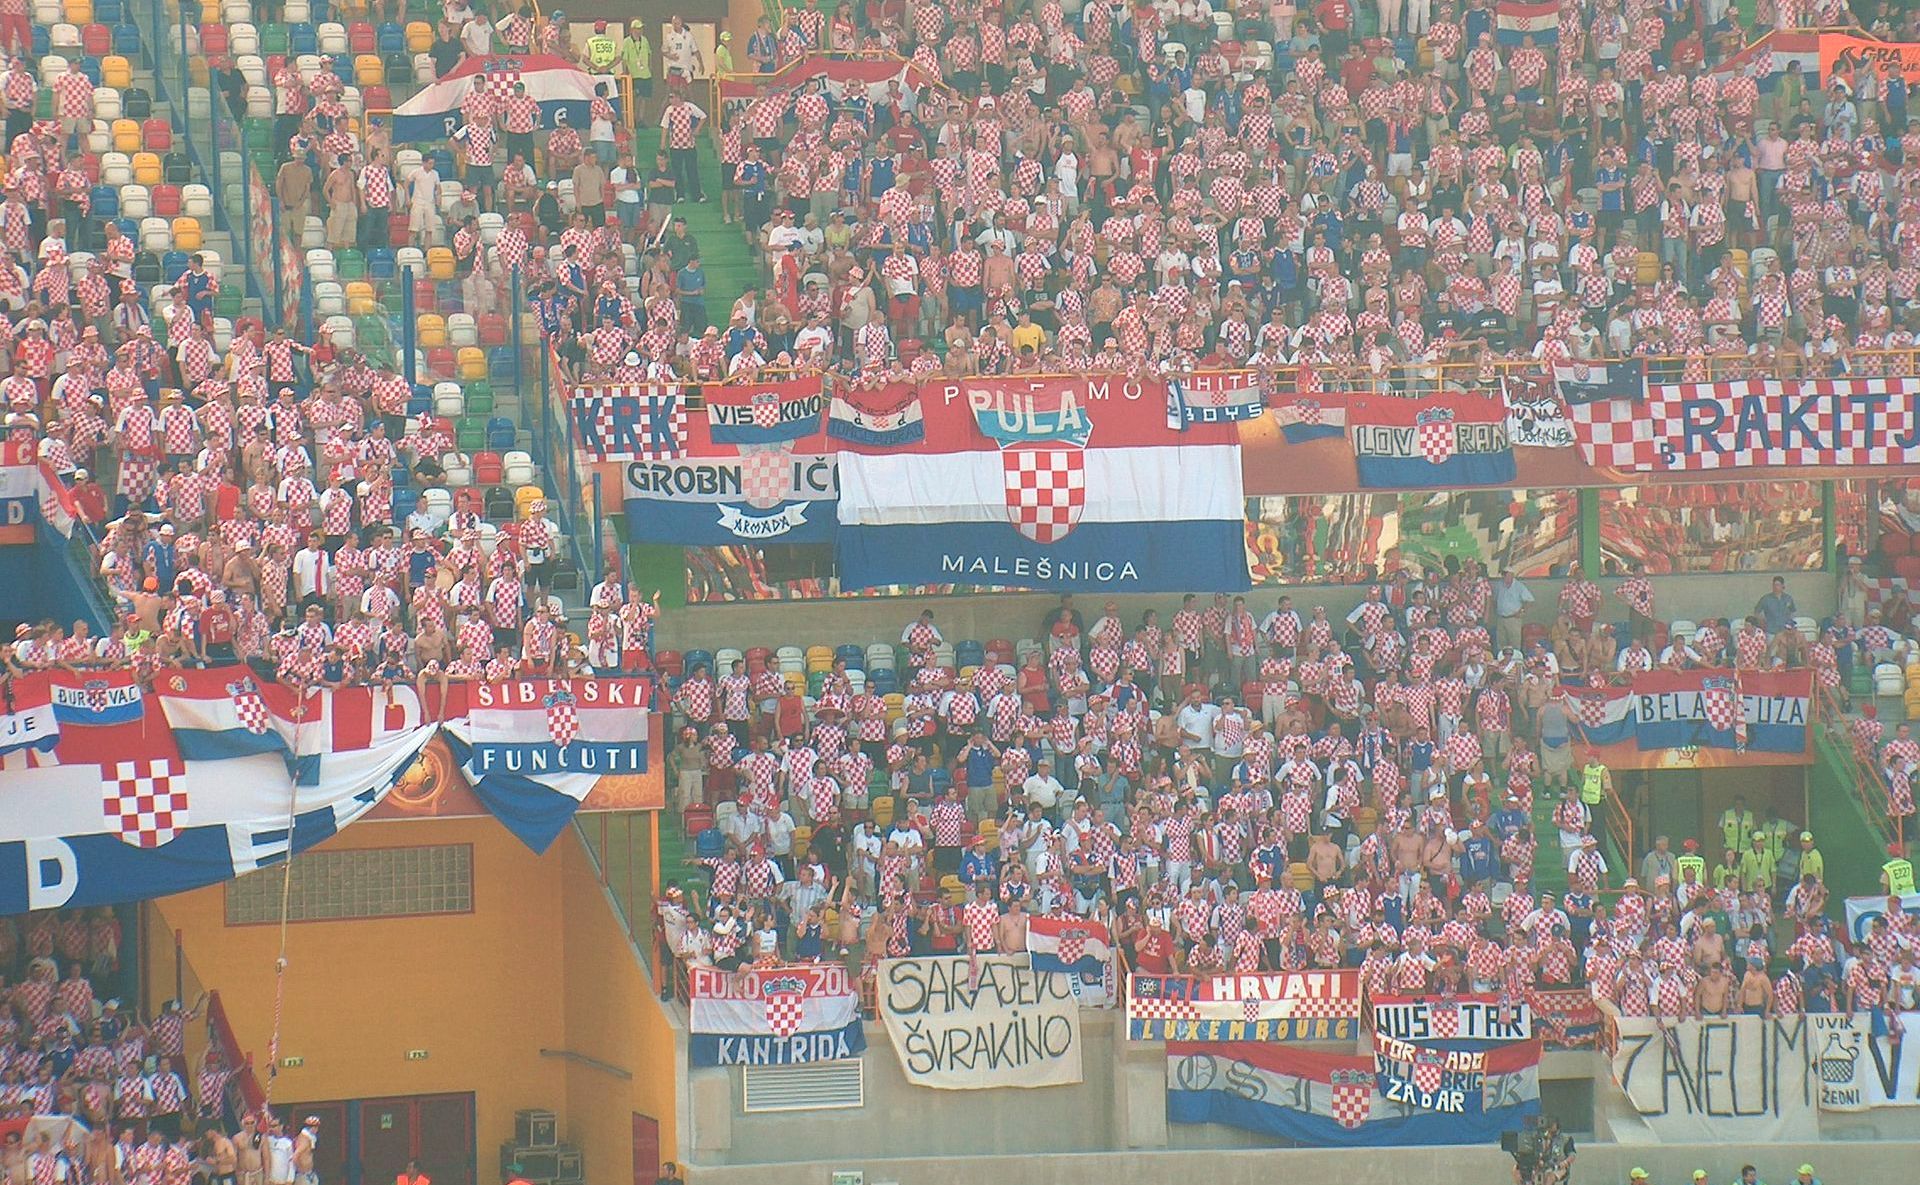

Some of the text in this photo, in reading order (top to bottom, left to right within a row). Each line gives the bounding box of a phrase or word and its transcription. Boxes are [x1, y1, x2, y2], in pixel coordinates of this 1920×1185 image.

[576, 396, 680, 455] KRK
[968, 389, 1084, 435] PULA
[733, 515, 791, 536] ARMADA
[942, 555, 1139, 581] MALEŠNICA
[478, 679, 643, 706] ŠIBENSKI
[888, 960, 1071, 1016] SARAJEVO
[1212, 974, 1341, 1001] HRVATI
[1143, 1018, 1349, 1042] LUXEMBOURG
[718, 1031, 851, 1065] KANTRIDA
